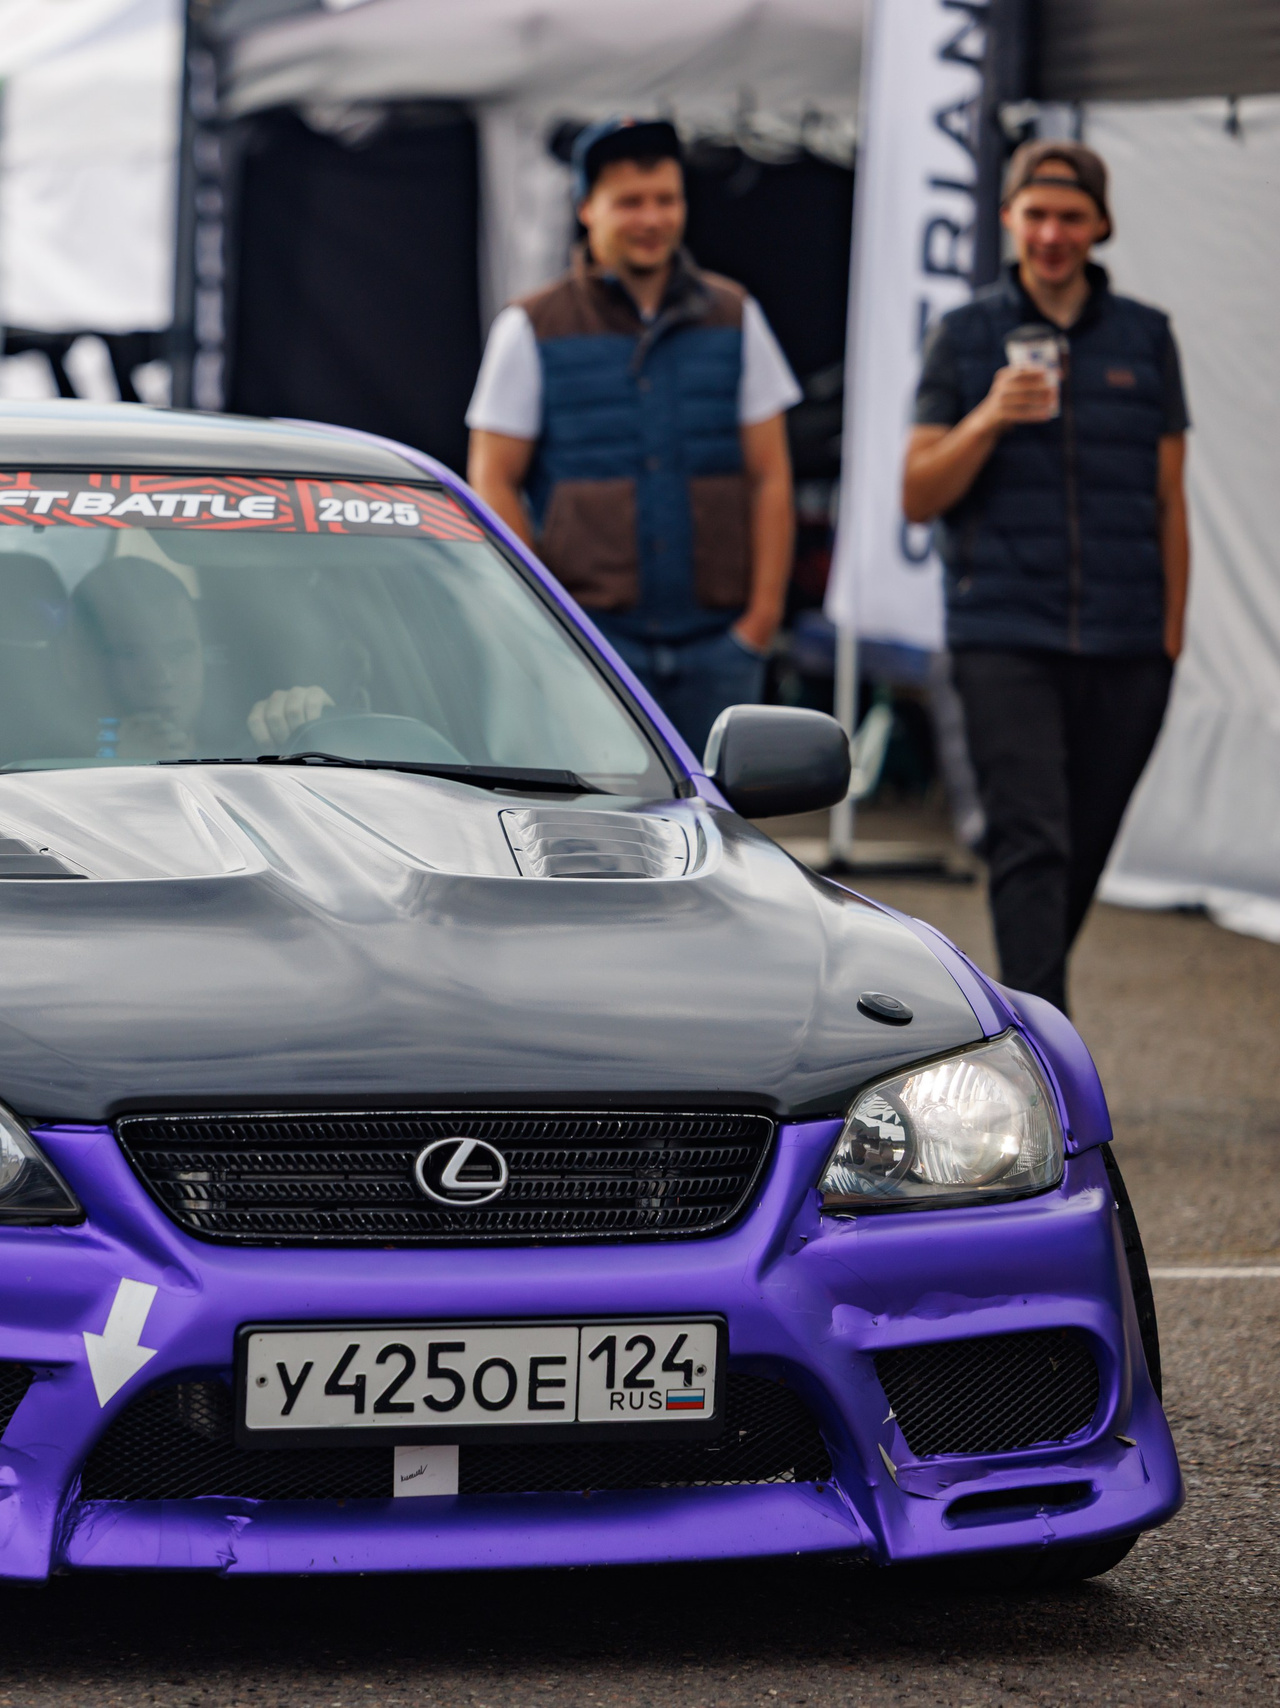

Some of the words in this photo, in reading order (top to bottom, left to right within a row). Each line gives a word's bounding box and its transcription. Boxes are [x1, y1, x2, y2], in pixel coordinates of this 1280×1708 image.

[69, 491, 277, 519] BATTLE
[318, 497, 420, 526] 2025
[588, 1333, 694, 1389] 124
[610, 1391, 663, 1411] RUS
